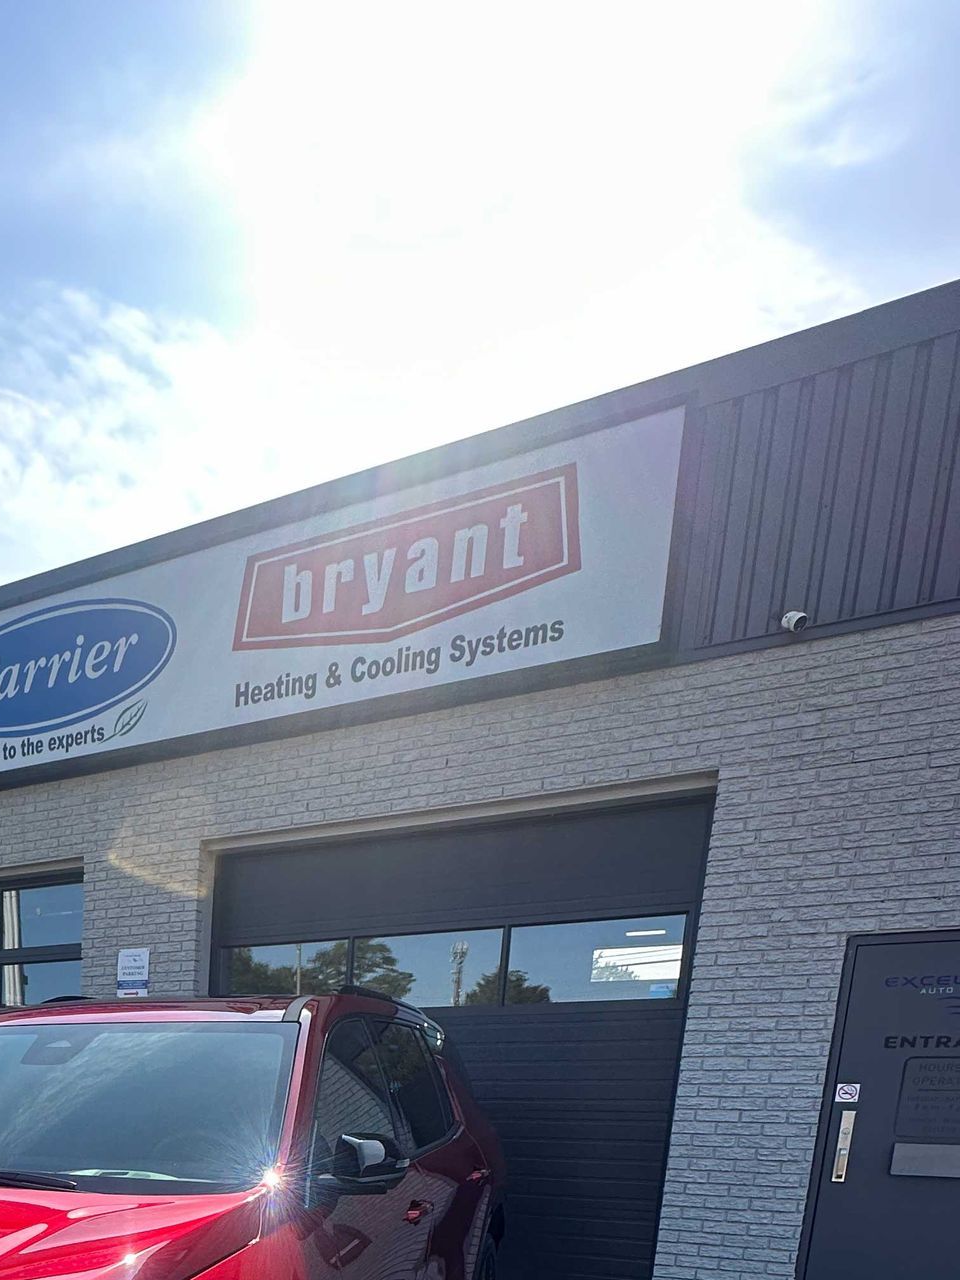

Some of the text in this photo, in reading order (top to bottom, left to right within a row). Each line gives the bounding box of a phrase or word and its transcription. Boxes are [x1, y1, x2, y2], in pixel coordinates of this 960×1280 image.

[281, 503, 528, 624] bryant
[234, 619, 564, 708] Heating & Cooling Systems
[2, 742, 17, 760] to
[20, 737, 44, 757] the
[48, 724, 105, 753] experts
[920, 986, 954, 995] AUTO
